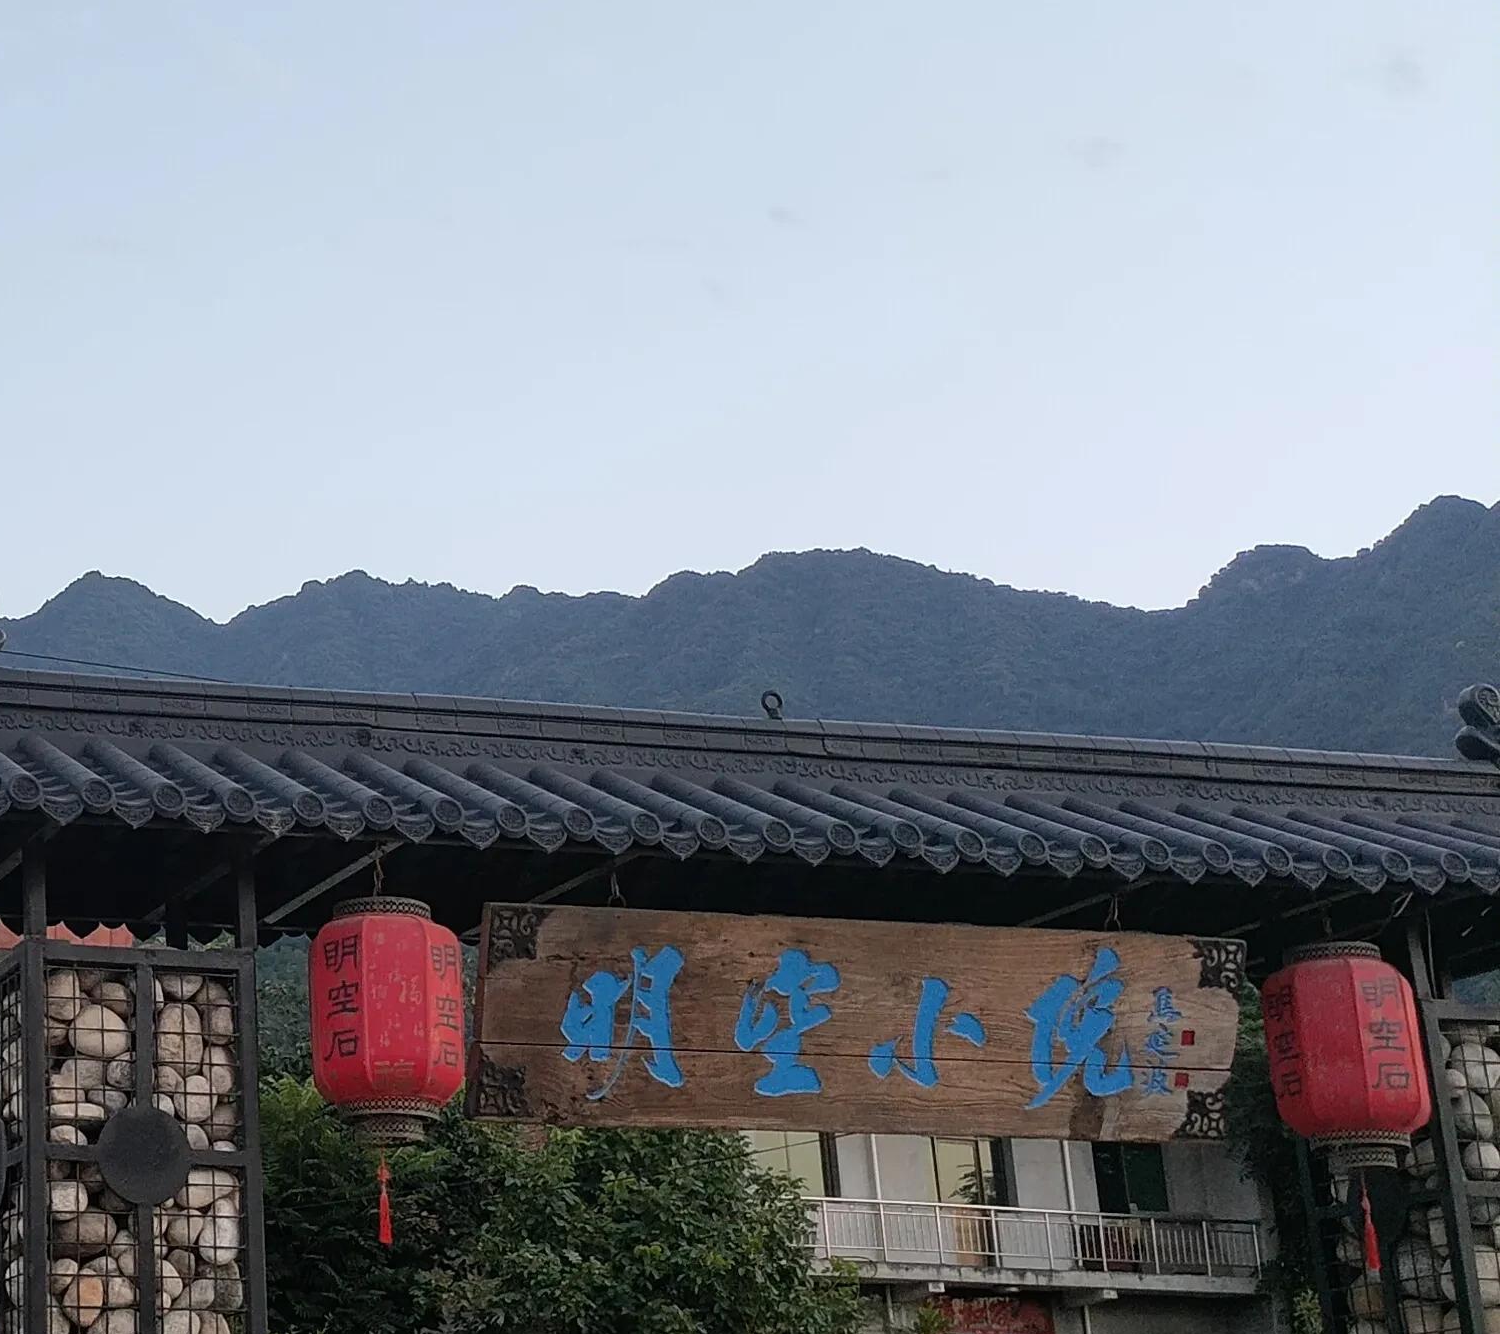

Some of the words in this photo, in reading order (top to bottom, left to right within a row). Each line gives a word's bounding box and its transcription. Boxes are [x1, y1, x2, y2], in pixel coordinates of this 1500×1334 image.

[323, 933, 361, 1062] 明空石
[430, 943, 460, 1068] 明空石
[1361, 975, 1411, 1090] 明空石
